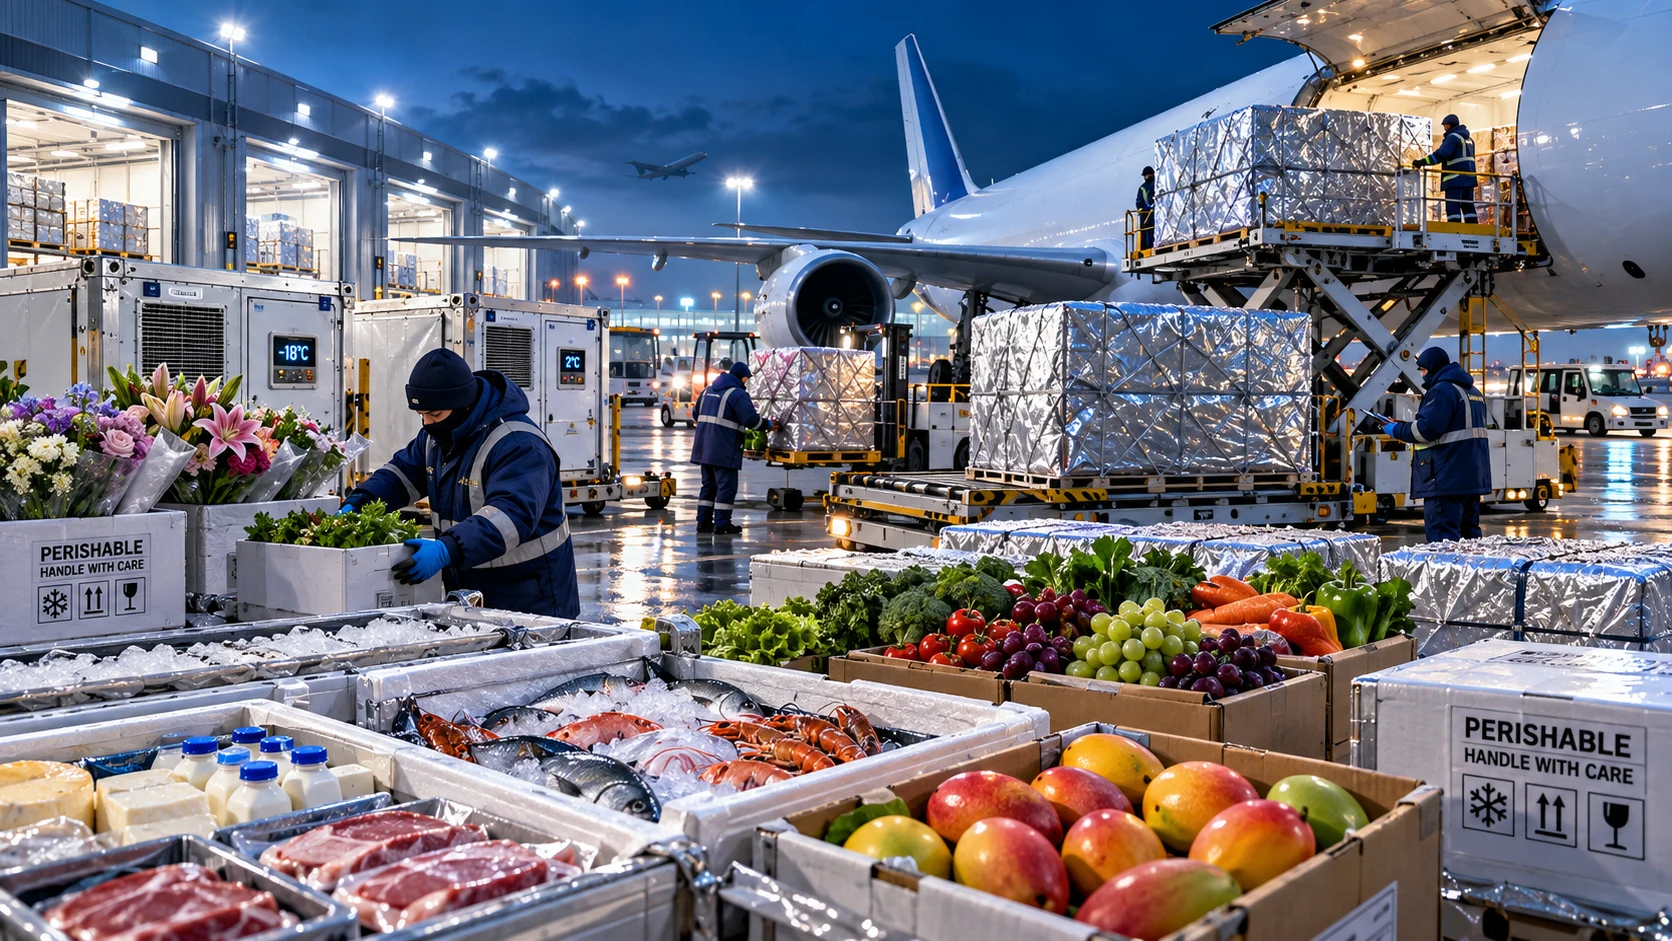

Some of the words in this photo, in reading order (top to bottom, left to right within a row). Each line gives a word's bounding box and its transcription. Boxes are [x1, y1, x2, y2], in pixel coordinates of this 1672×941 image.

[278, 344, 309, 361] -18°C
[565, 355, 580, 369] 2°C
[41, 539, 143, 562] PERISHABLE
[40, 564, 85, 578] HANDLE
[88, 561, 115, 574] WITH
[117, 559, 144, 572] CARE
[1465, 716, 1631, 758] PERISHABLE
[1464, 747, 1530, 770] HANDLE
[1535, 756, 1580, 777] WITH
[1585, 763, 1634, 785] CARE
